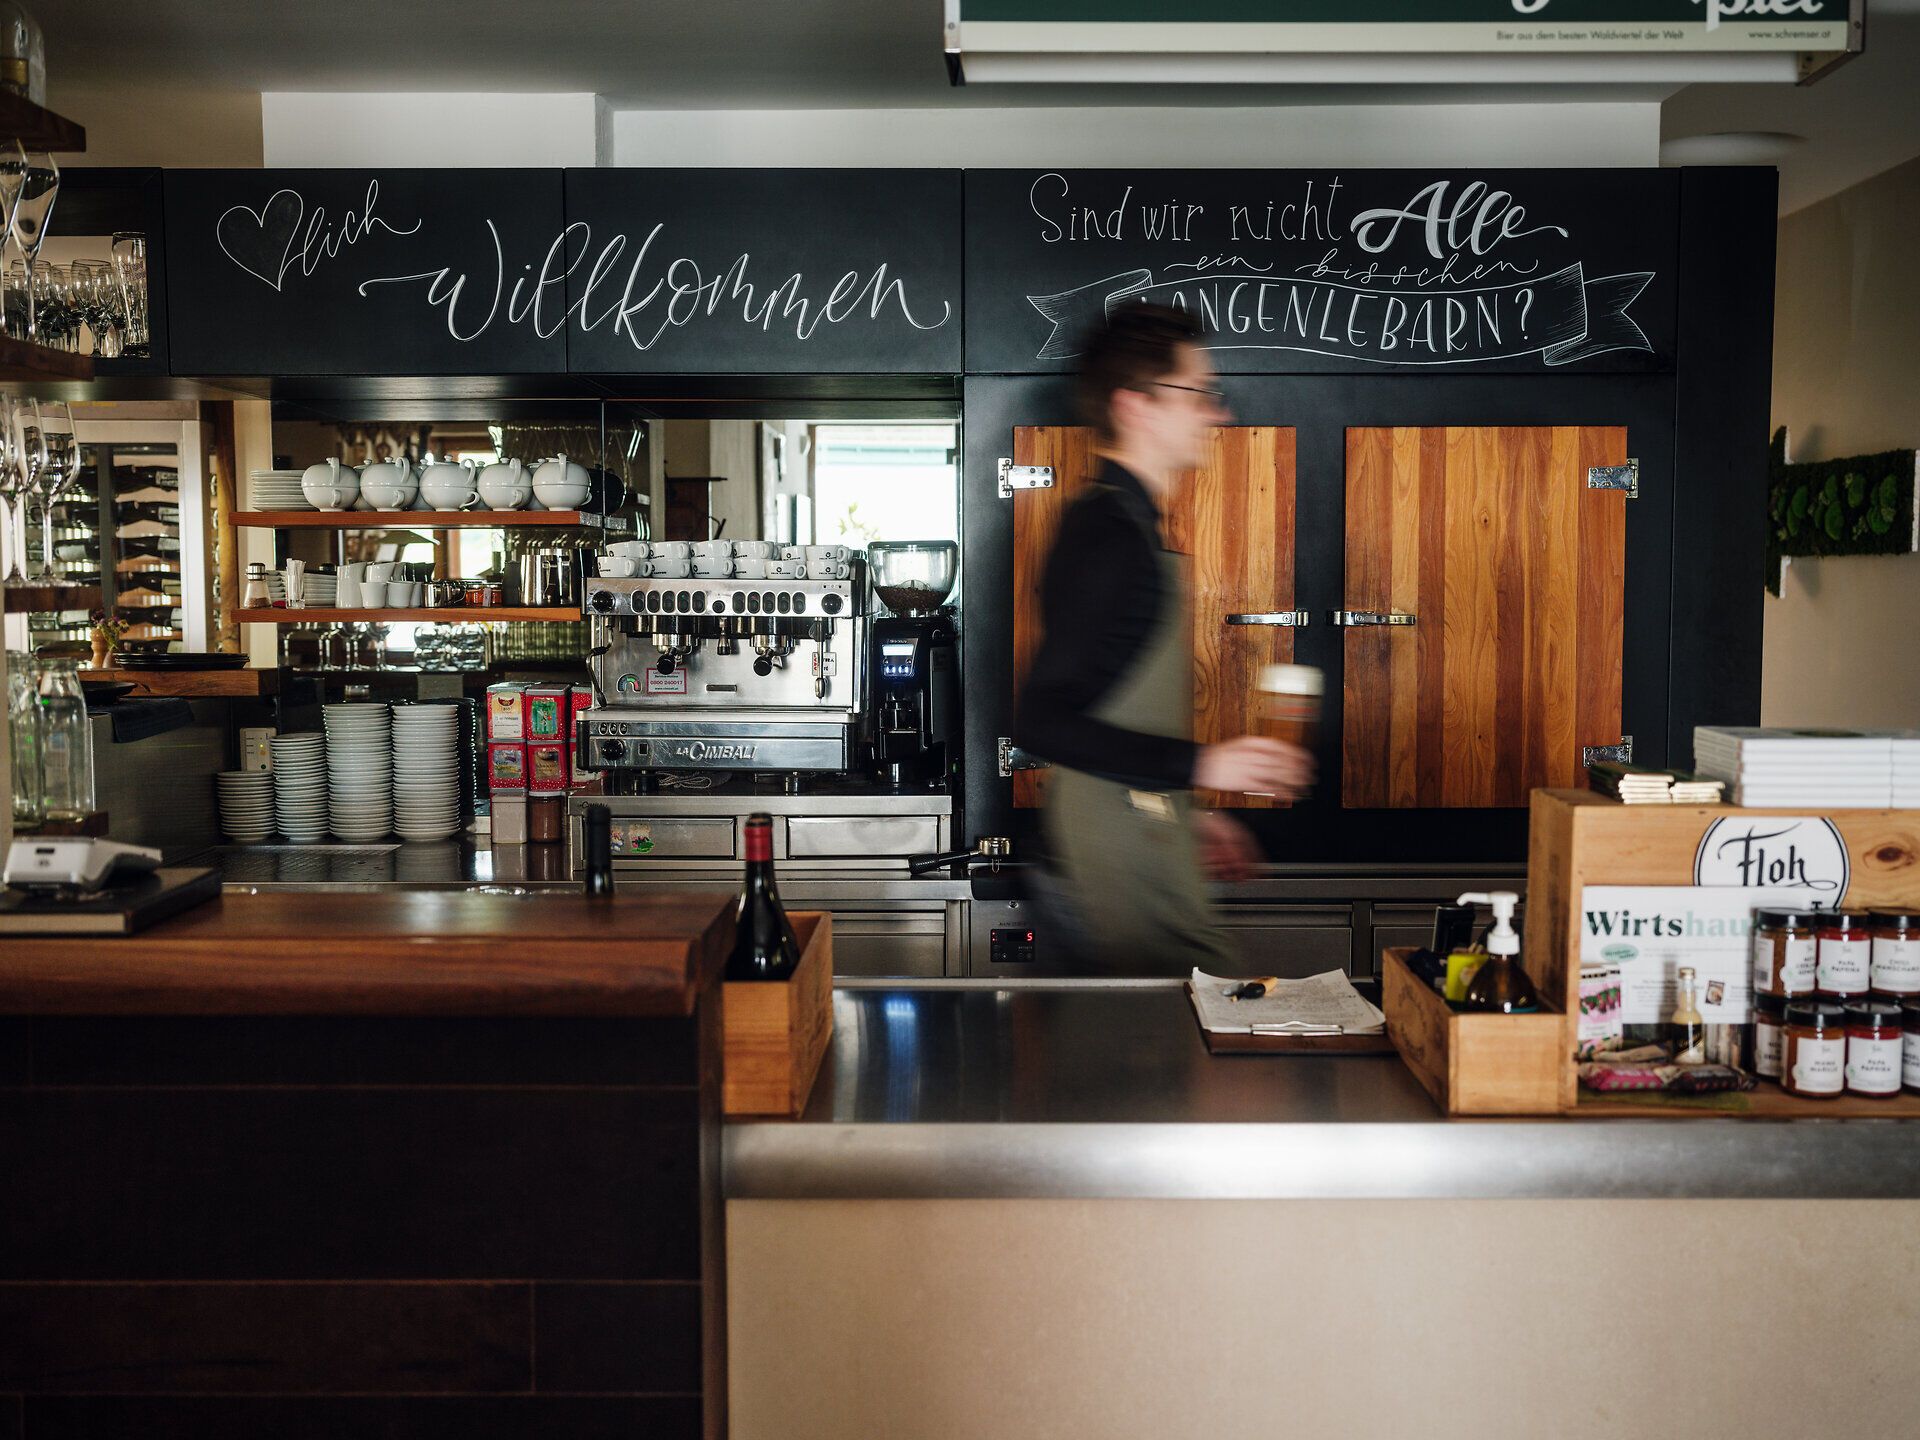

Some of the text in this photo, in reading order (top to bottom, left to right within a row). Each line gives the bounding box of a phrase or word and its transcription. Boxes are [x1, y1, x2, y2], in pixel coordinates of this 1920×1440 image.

[1497, 30, 1685, 40] Bier aus dem besten Waldviertel der Welt
[1748, 29, 1832, 40] www.schremser.at
[1030, 173, 1569, 260] Sind wir nicht Alle
[358, 219, 951, 351] Willkommen
[1164, 248, 1539, 287] ein bisschen
[1139, 281, 1536, 353] NGENLEBARN?
[1717, 821, 1838, 890] Floh
